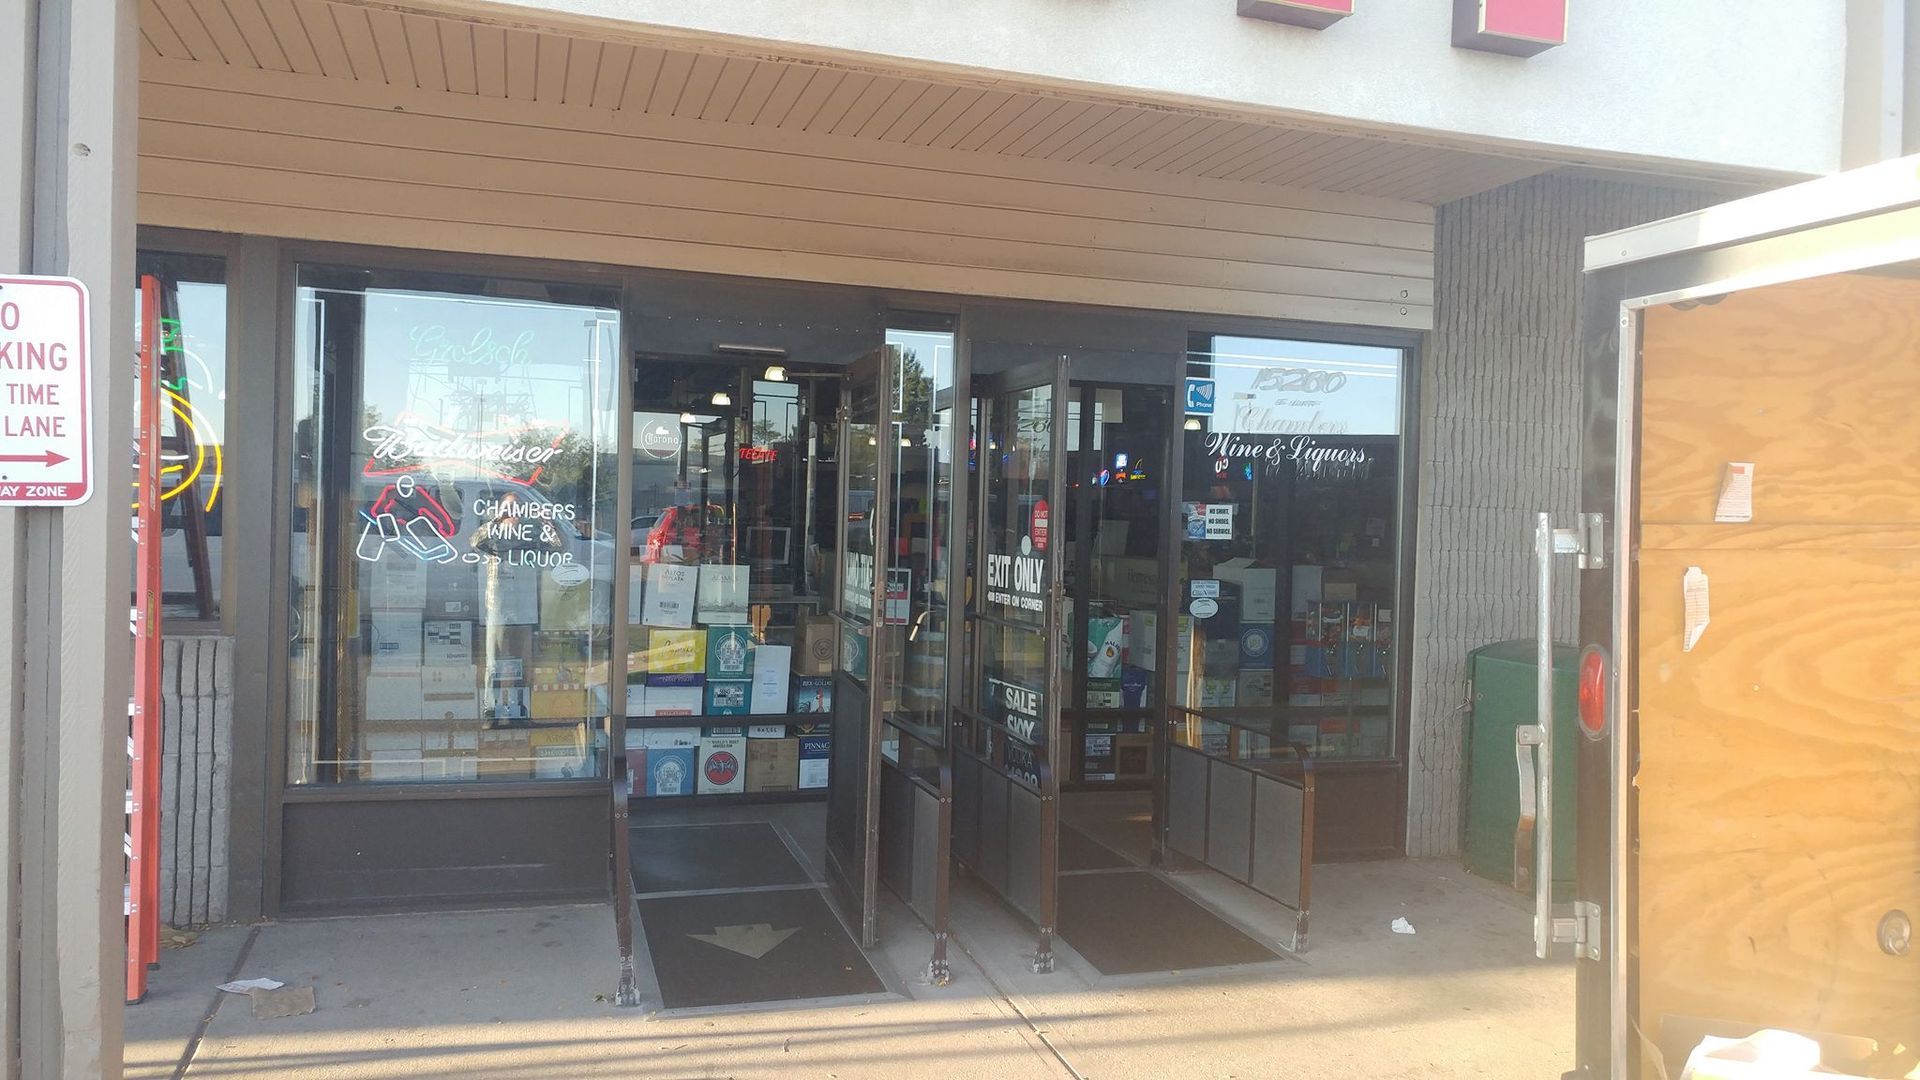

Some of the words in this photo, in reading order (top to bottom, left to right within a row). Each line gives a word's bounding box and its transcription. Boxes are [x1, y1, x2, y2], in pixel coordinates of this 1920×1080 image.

[409, 325, 534, 366] Grolsch
[1250, 367, 1347, 393] 15260
[6, 383, 60, 405] TIME
[4, 415, 66, 437] LANE
[363, 426, 563, 463] Budweiser
[646, 433, 679, 445] Corona
[1205, 431, 1264, 457] Wine
[1266, 438, 1286, 466] &
[740, 448, 777, 462] TECATE
[0, 486, 20, 497] AY
[26, 485, 68, 497] ZONE
[473, 499, 576, 520] CHAMBERS
[487, 522, 533, 541] WINE
[540, 524, 556, 542] &
[508, 549, 573, 568] LIQUOR
[987, 553, 1011, 589] EXIT
[1013, 556, 1044, 594] ONLY
[995, 592, 1011, 606] ENTER
[1011, 595, 1020, 607] ON
[1020, 596, 1043, 612] CORNER
[1005, 686, 1037, 716] SALE
